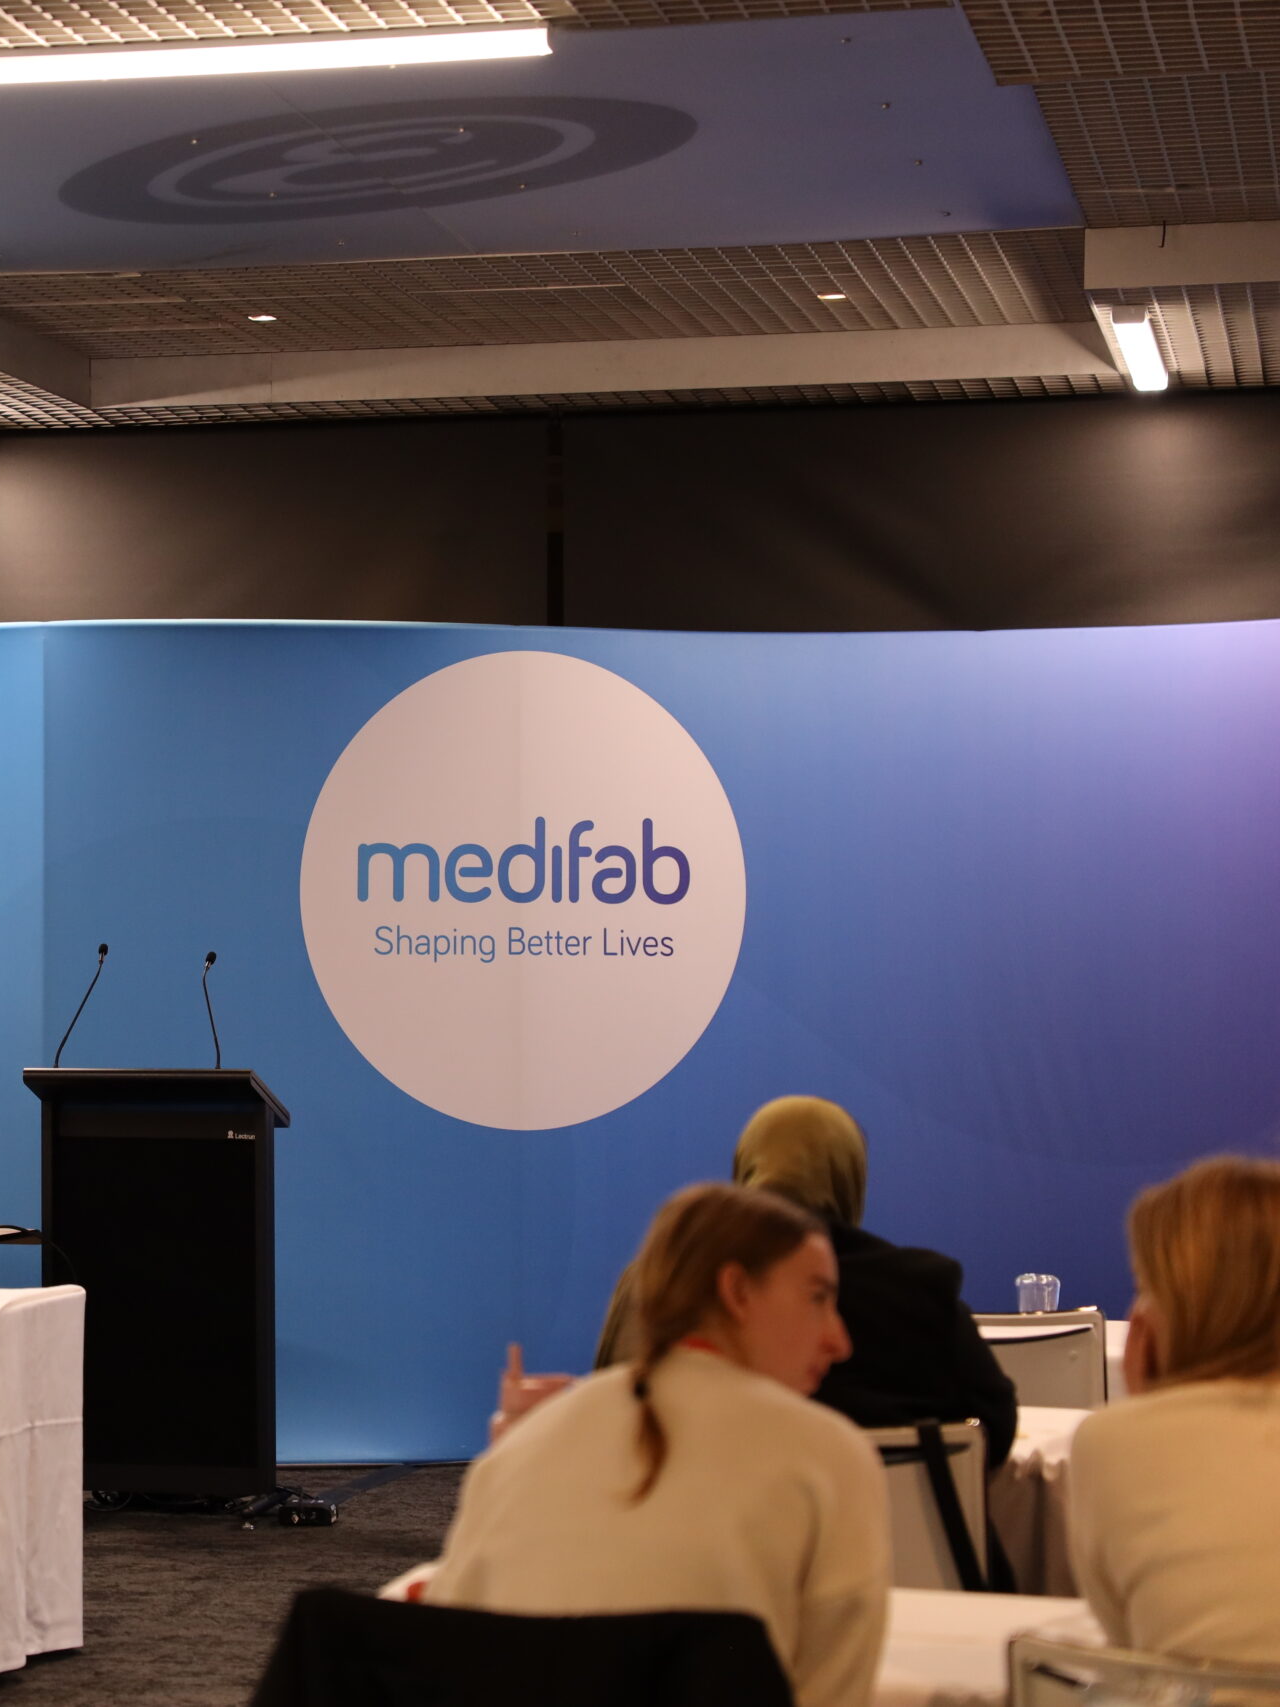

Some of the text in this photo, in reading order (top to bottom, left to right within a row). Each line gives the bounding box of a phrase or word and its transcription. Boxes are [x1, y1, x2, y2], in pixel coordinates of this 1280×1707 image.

[357, 816, 691, 905] medifab
[373, 925, 674, 963] Shaping Better Lives
